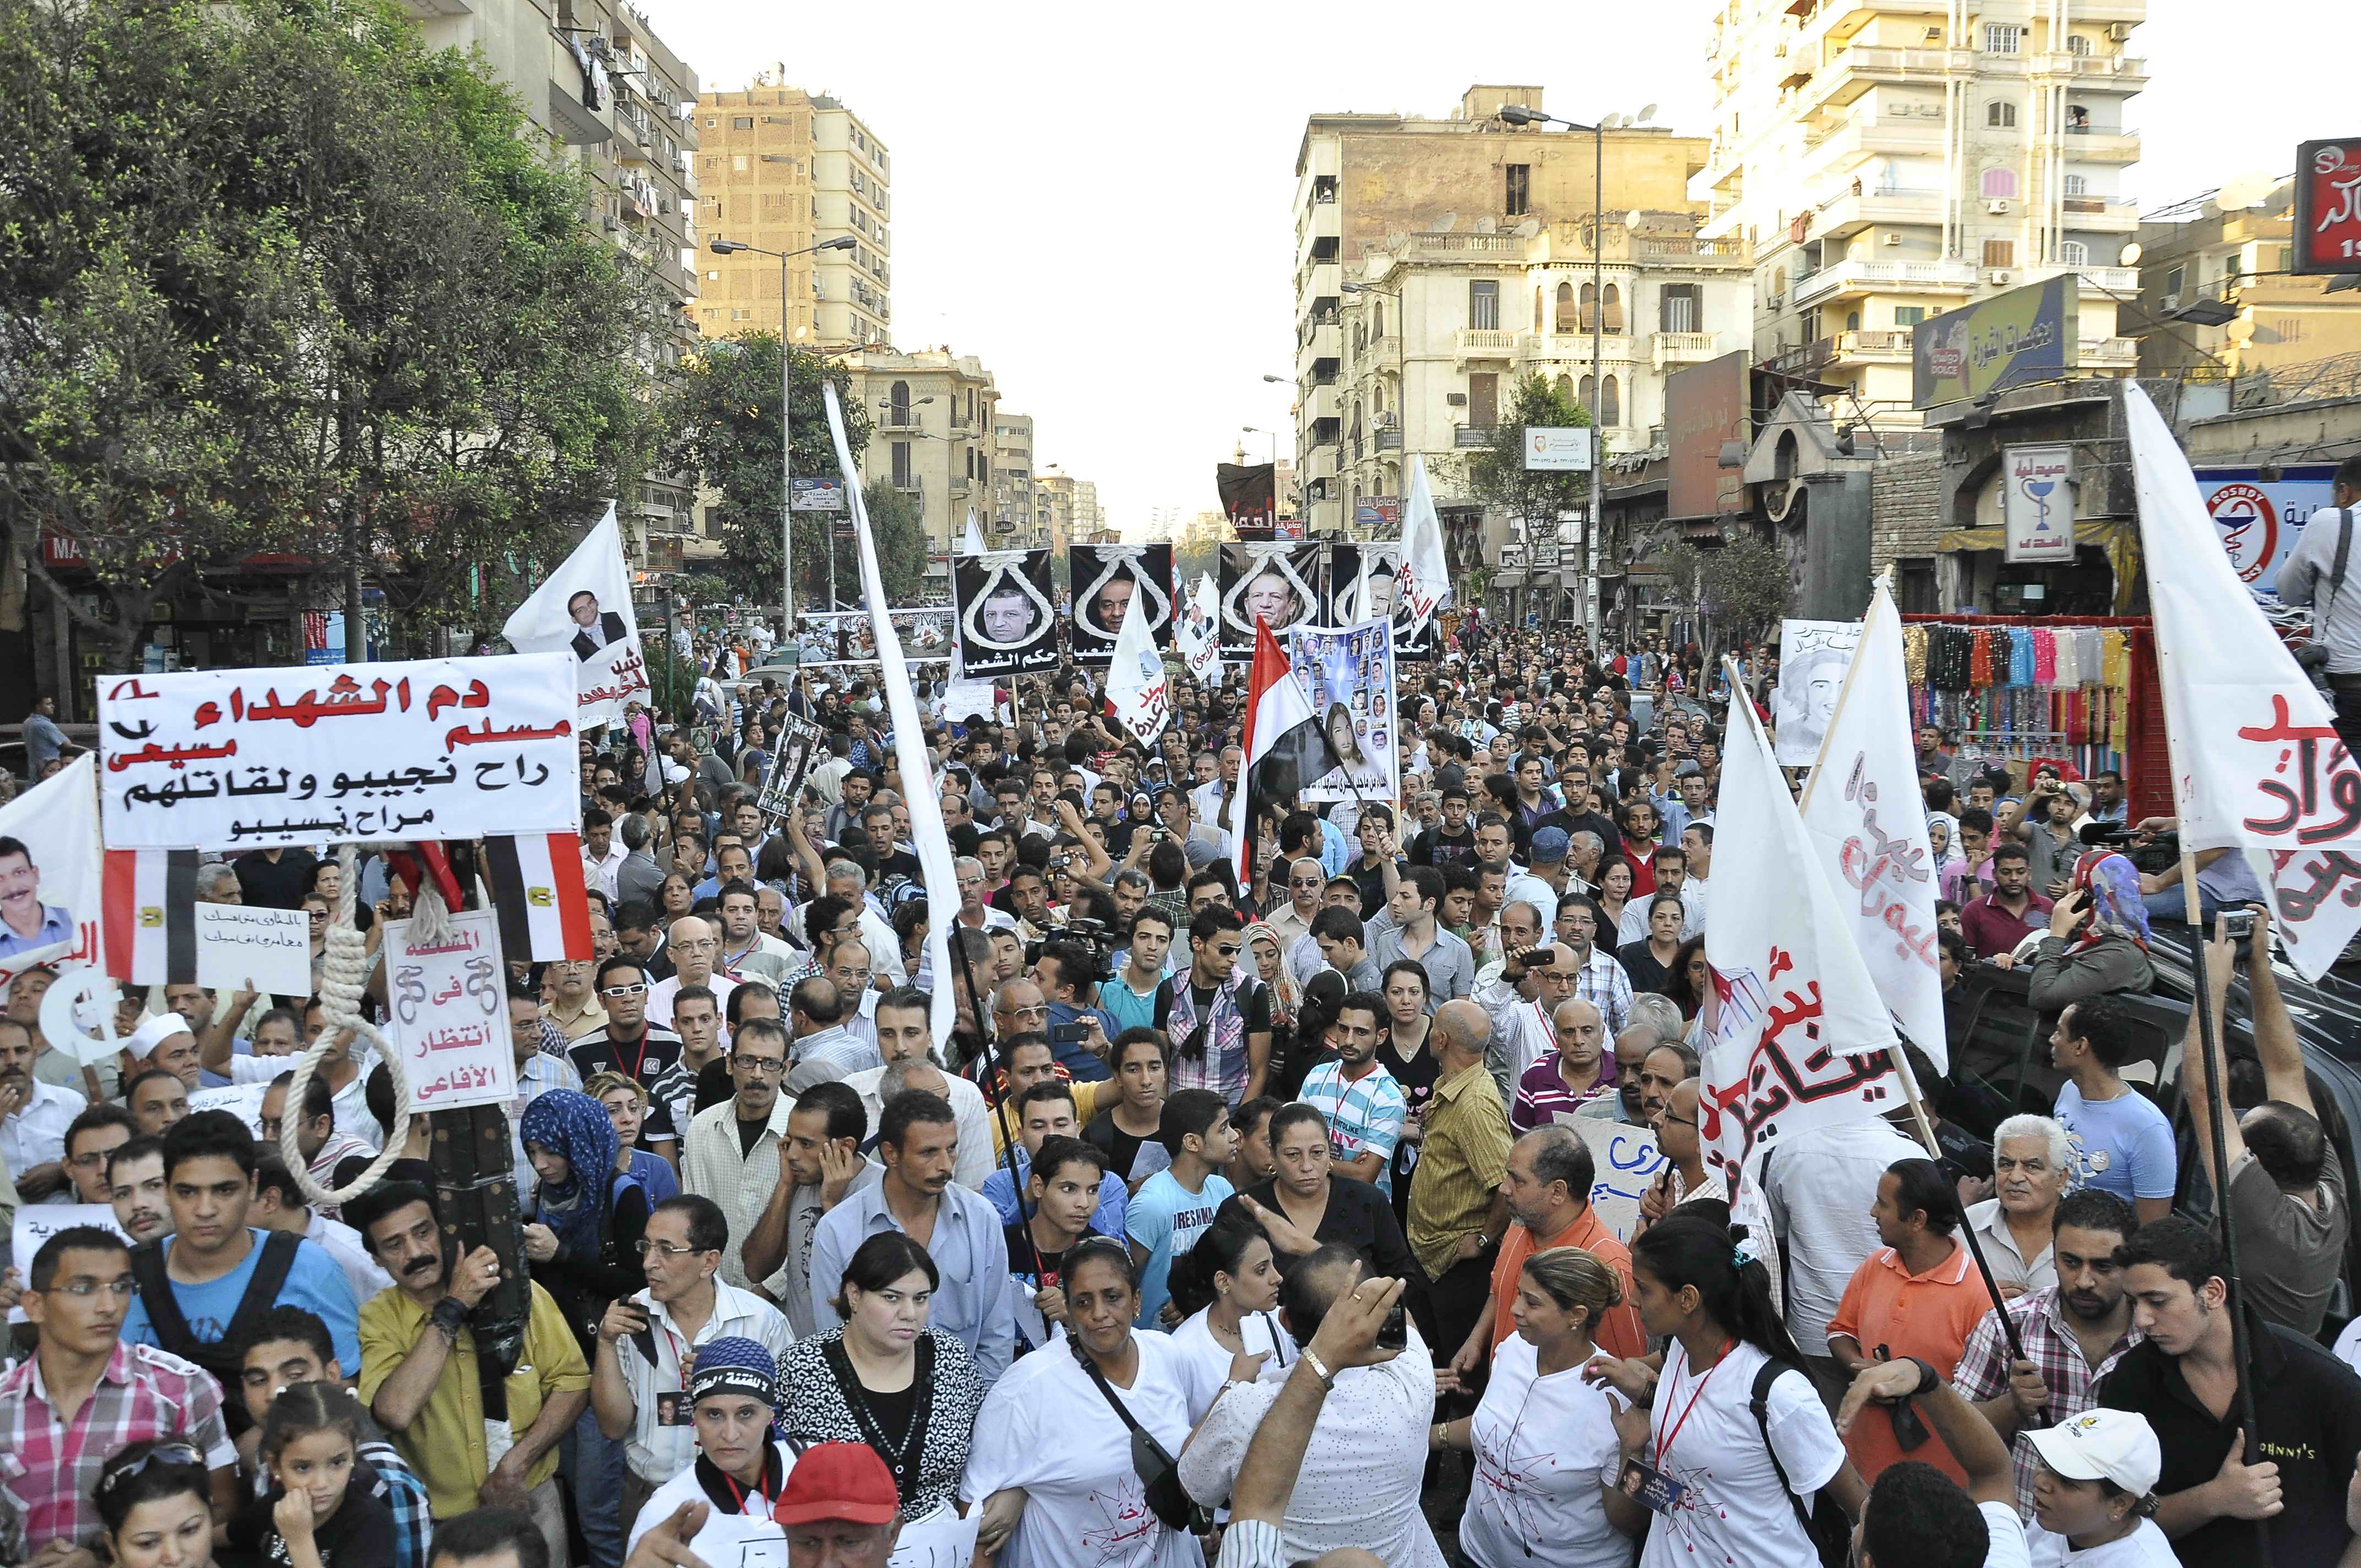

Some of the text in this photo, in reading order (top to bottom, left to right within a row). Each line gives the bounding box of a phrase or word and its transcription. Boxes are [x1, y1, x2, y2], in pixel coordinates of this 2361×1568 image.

[1372, 497, 1397, 510] معامل
[2211, 487, 2264, 504] ROSHDY
[964, 652, 1018, 674] الشعب
[1022, 648, 1058, 669] حكم
[194, 673, 489, 731] دم الشهداء
[107, 716, 572, 772] مسلم مسيحى
[123, 753, 549, 812] راح نجيبو ولقاتلهم
[355, 804, 434, 836] مراح
[414, 1021, 492, 1059] أنتظار
[417, 1063, 497, 1100] الأفاعى
[1331, 1129, 1360, 1149] NY
[1173, 1206, 1218, 1231] RESHMA
[724, 1371, 761, 1389] للفتنة
[760, 1380, 769, 1393] لا
[2259, 1442, 2316, 1460] OHNNY'S
[1118, 1501, 1147, 1520] رخة
